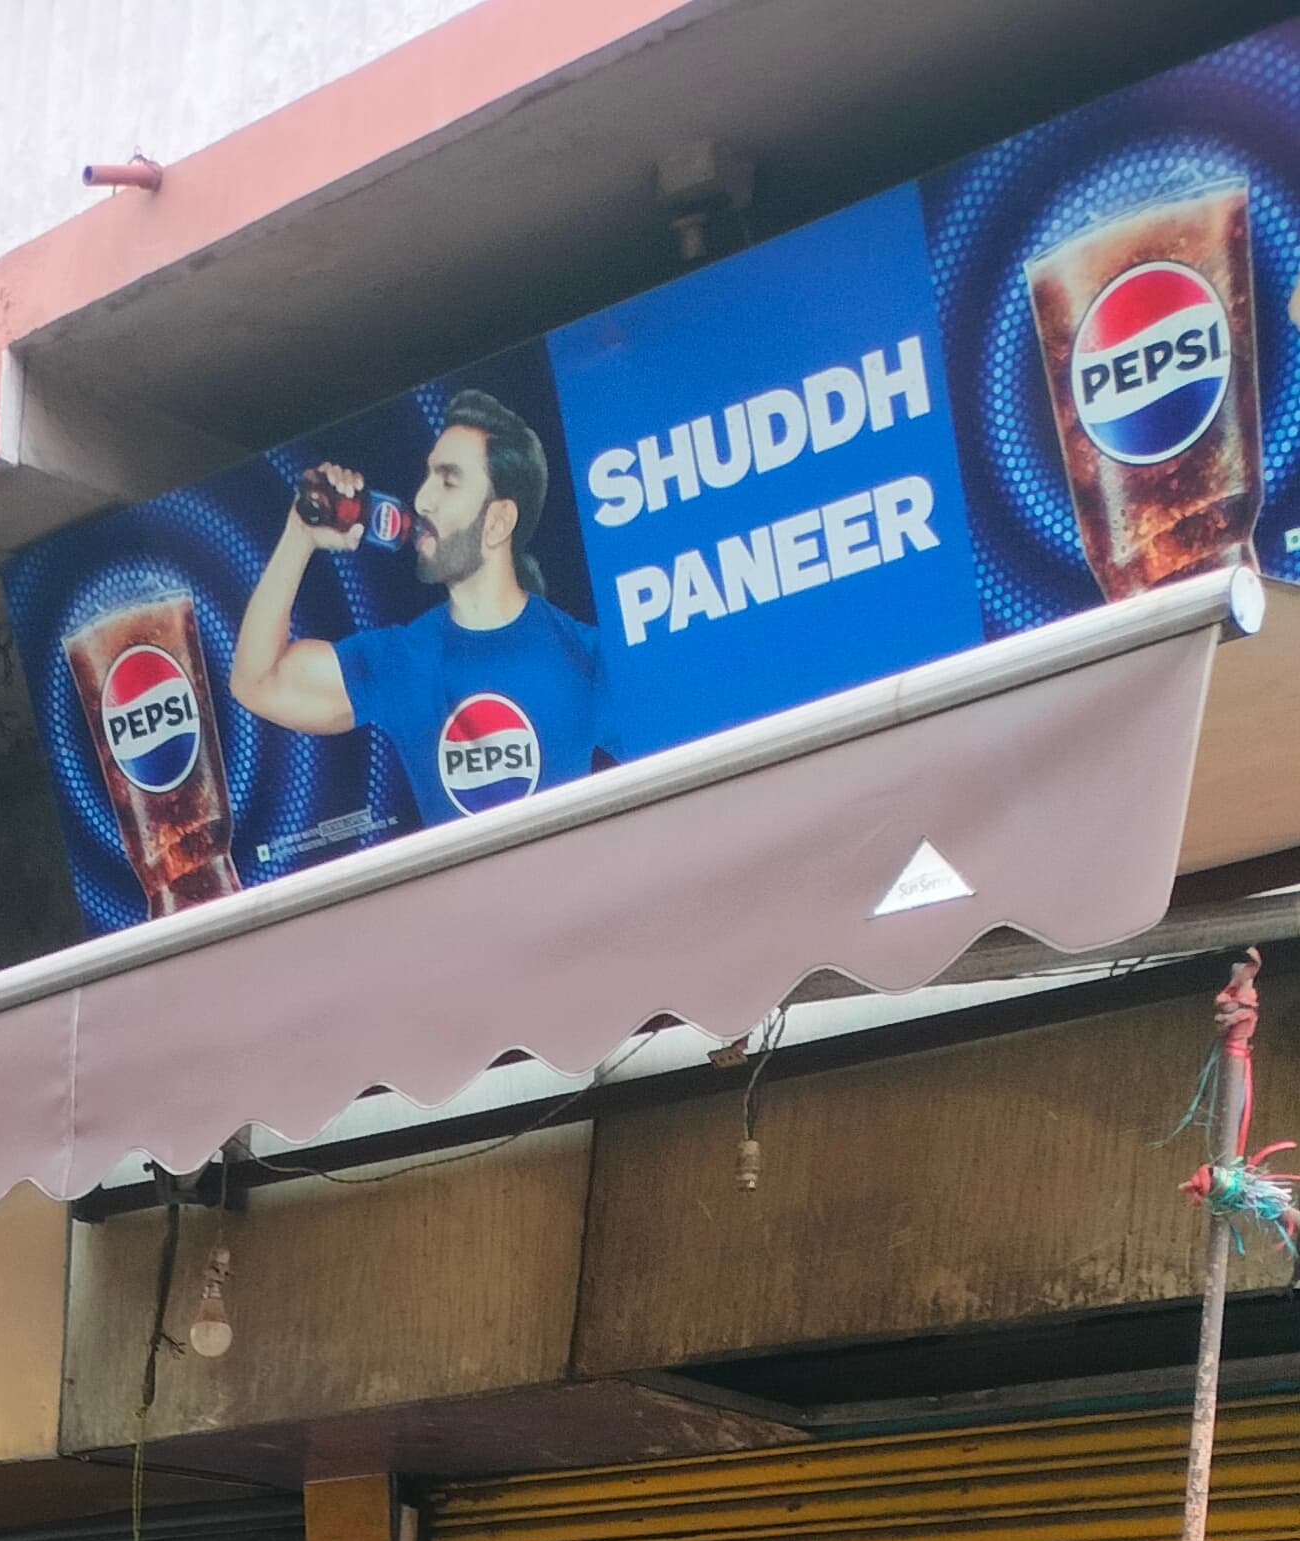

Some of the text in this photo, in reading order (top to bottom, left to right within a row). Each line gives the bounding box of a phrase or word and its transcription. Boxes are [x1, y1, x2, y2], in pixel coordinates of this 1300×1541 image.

[1080, 320, 1222, 406] PEPSI
[587, 335, 932, 528] SHUDDH
[615, 474, 941, 647] PANEER
[107, 691, 194, 747] PEPSI
[444, 742, 534, 776] PEPSI
